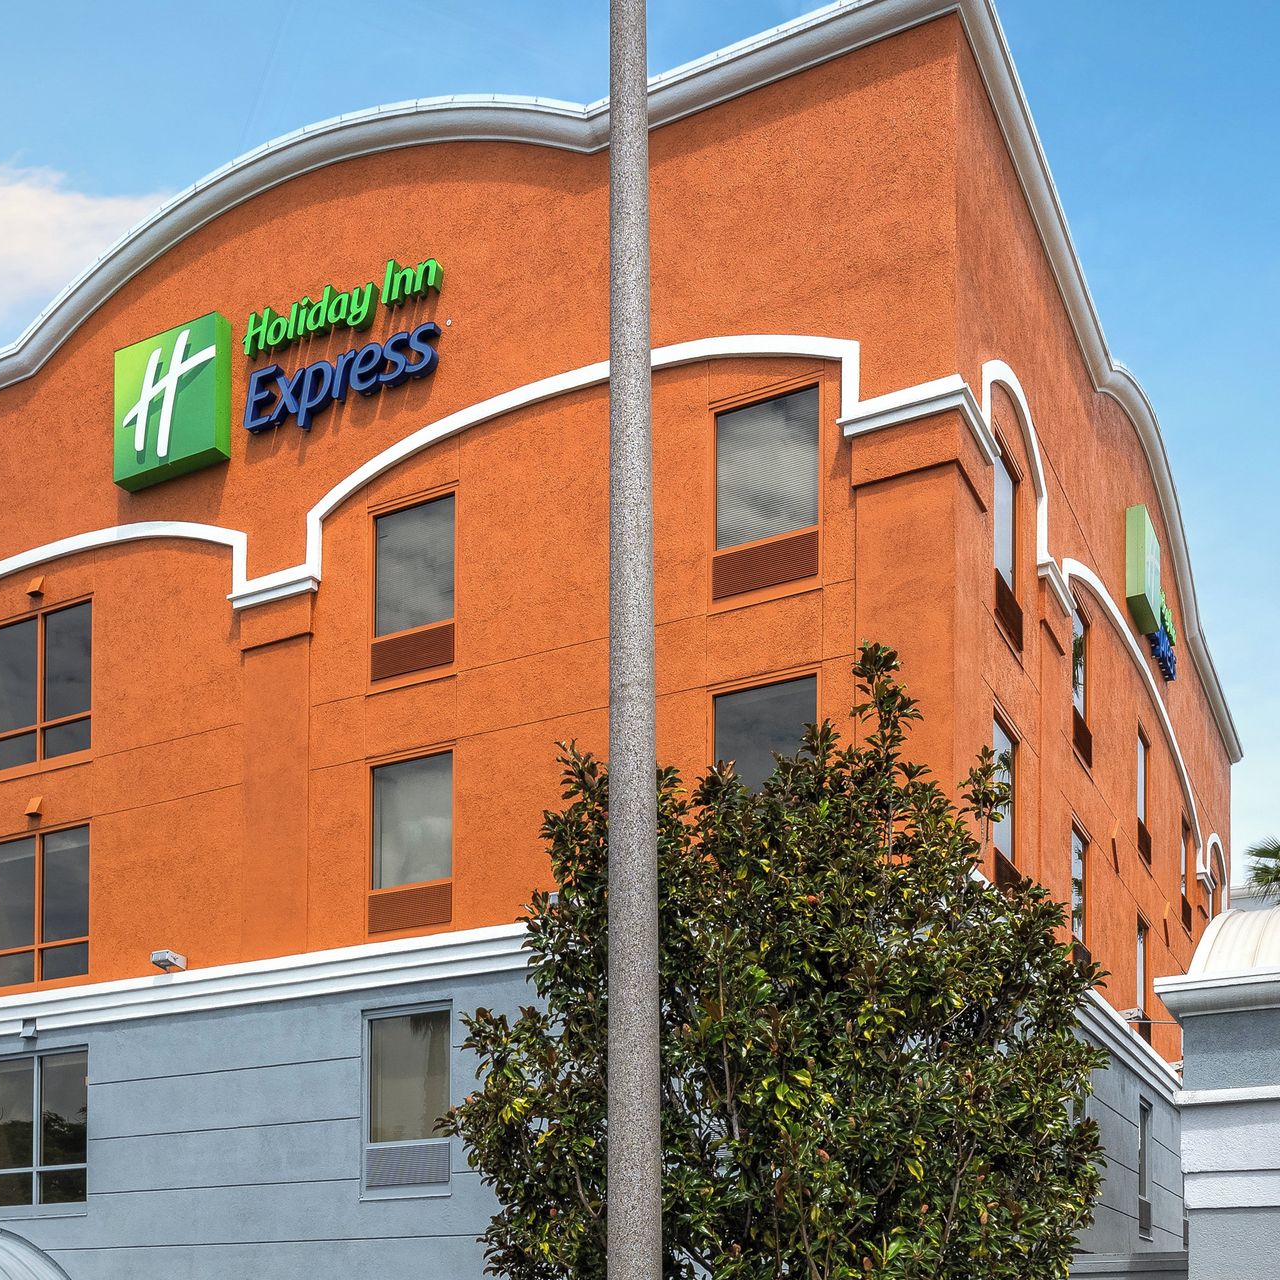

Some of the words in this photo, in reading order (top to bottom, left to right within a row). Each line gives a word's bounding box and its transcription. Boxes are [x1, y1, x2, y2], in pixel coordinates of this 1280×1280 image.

[243, 283, 378, 358] Holiday
[381, 259, 443, 306] Inn
[243, 322, 442, 433] Express
